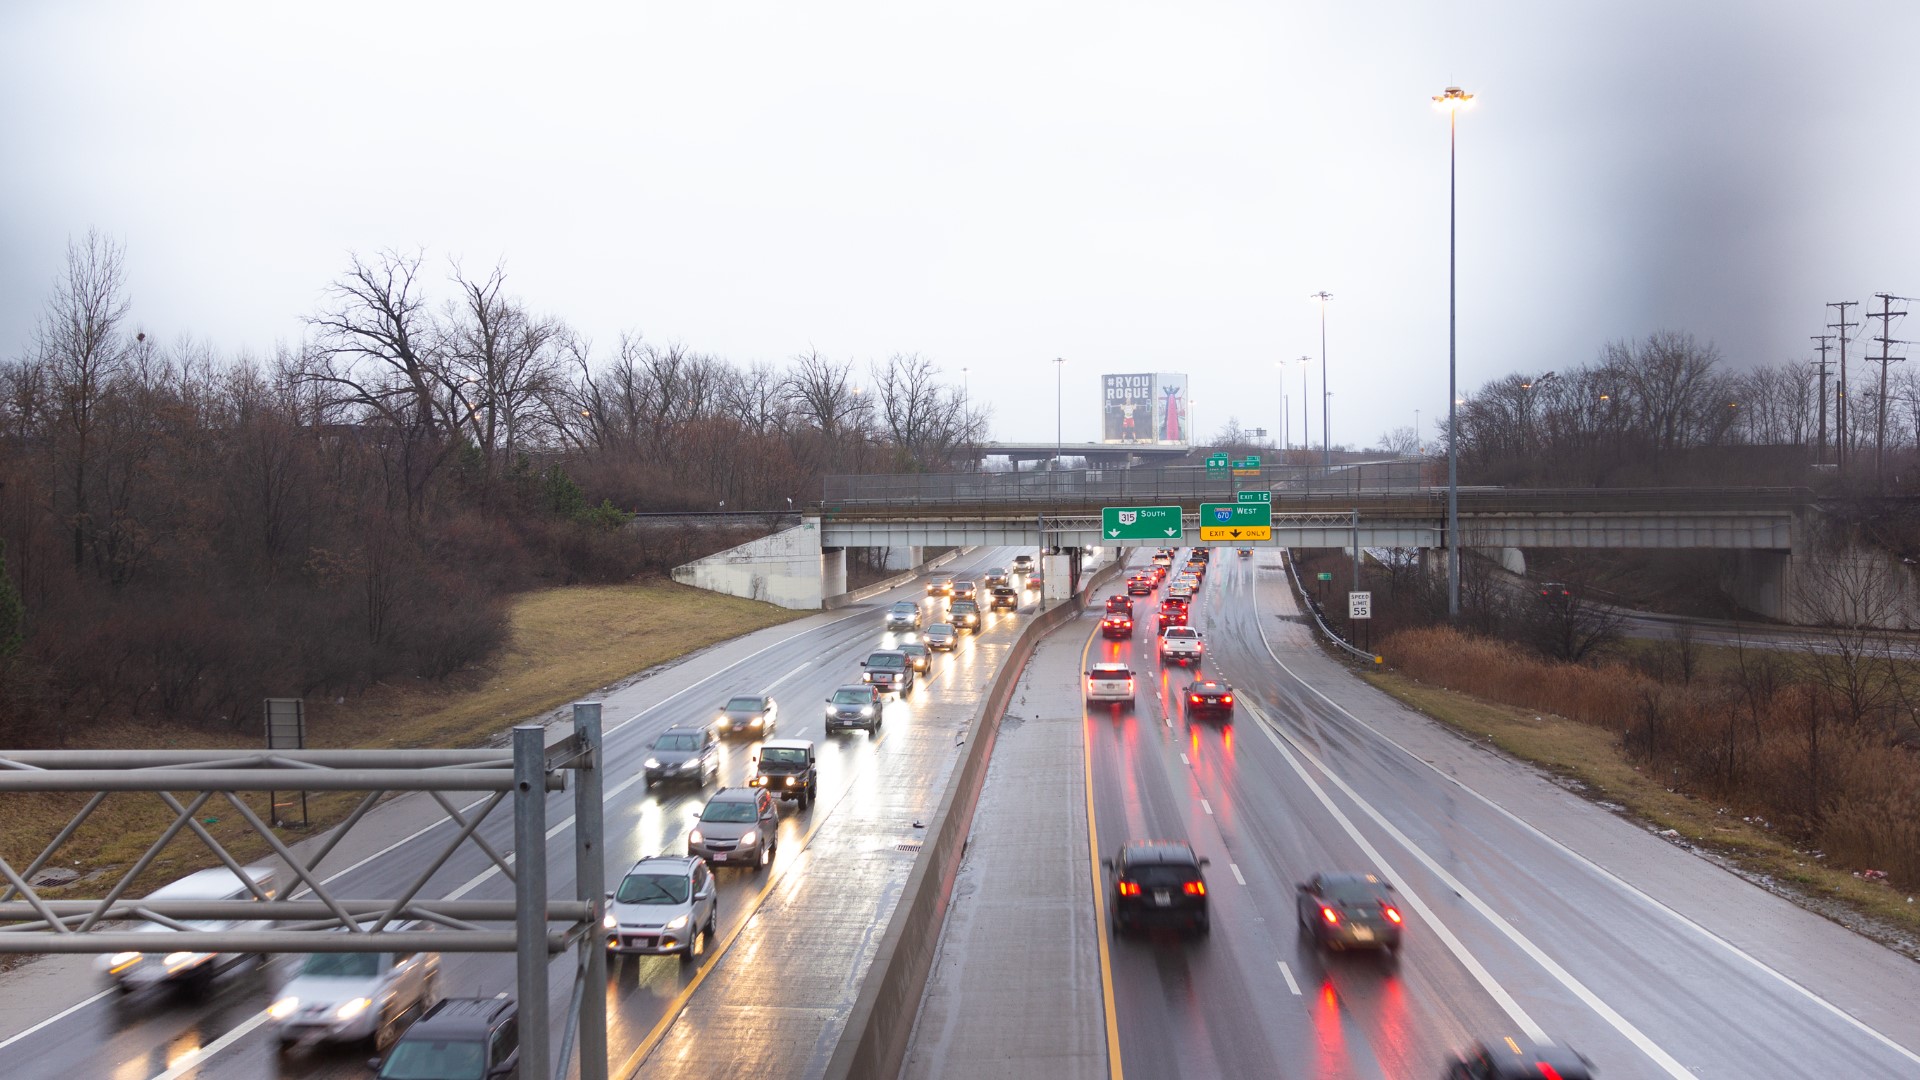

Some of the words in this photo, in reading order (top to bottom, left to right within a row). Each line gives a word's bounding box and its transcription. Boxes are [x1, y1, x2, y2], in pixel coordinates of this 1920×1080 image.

[1107, 376, 1149, 388] #RYOU
[1107, 387, 1149, 399] ROGUE
[1121, 513, 1135, 522] 315
